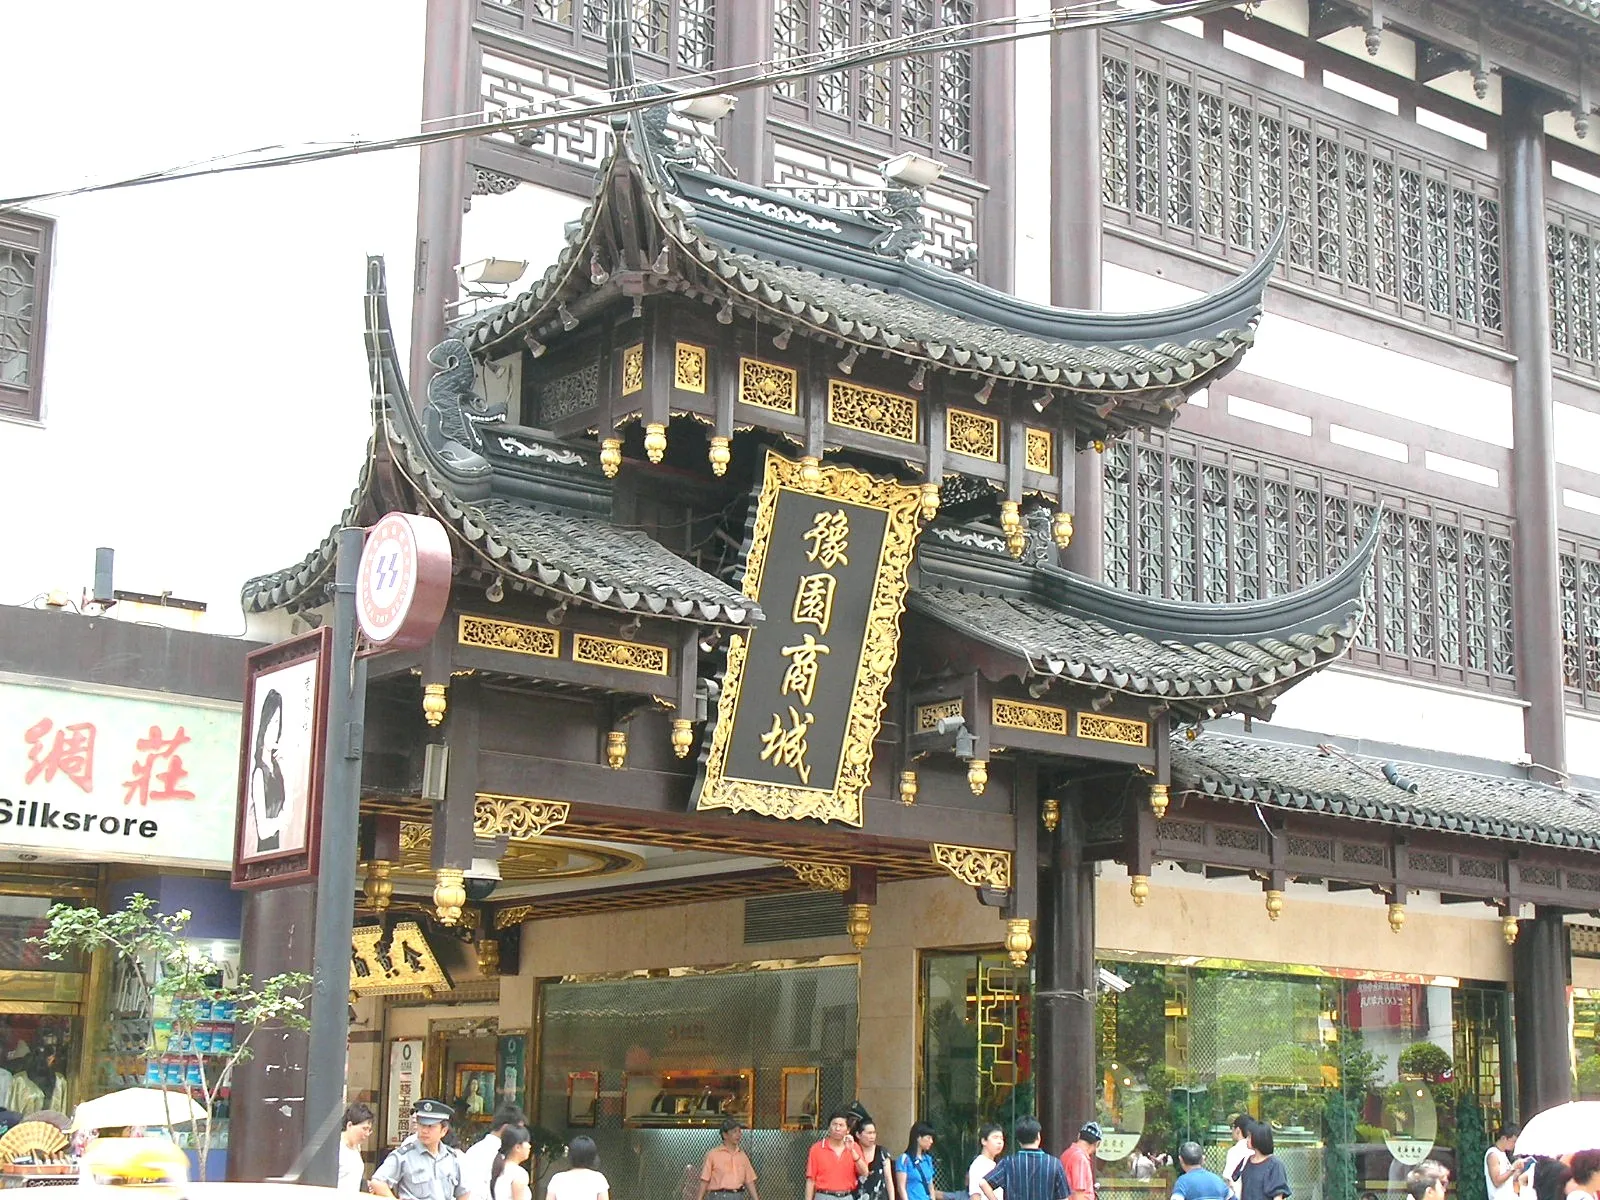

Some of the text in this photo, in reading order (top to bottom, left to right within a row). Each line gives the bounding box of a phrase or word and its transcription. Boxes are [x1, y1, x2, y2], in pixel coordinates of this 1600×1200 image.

[759, 508, 850, 785] 豫園商城
[0, 797, 158, 838] Silksrore
